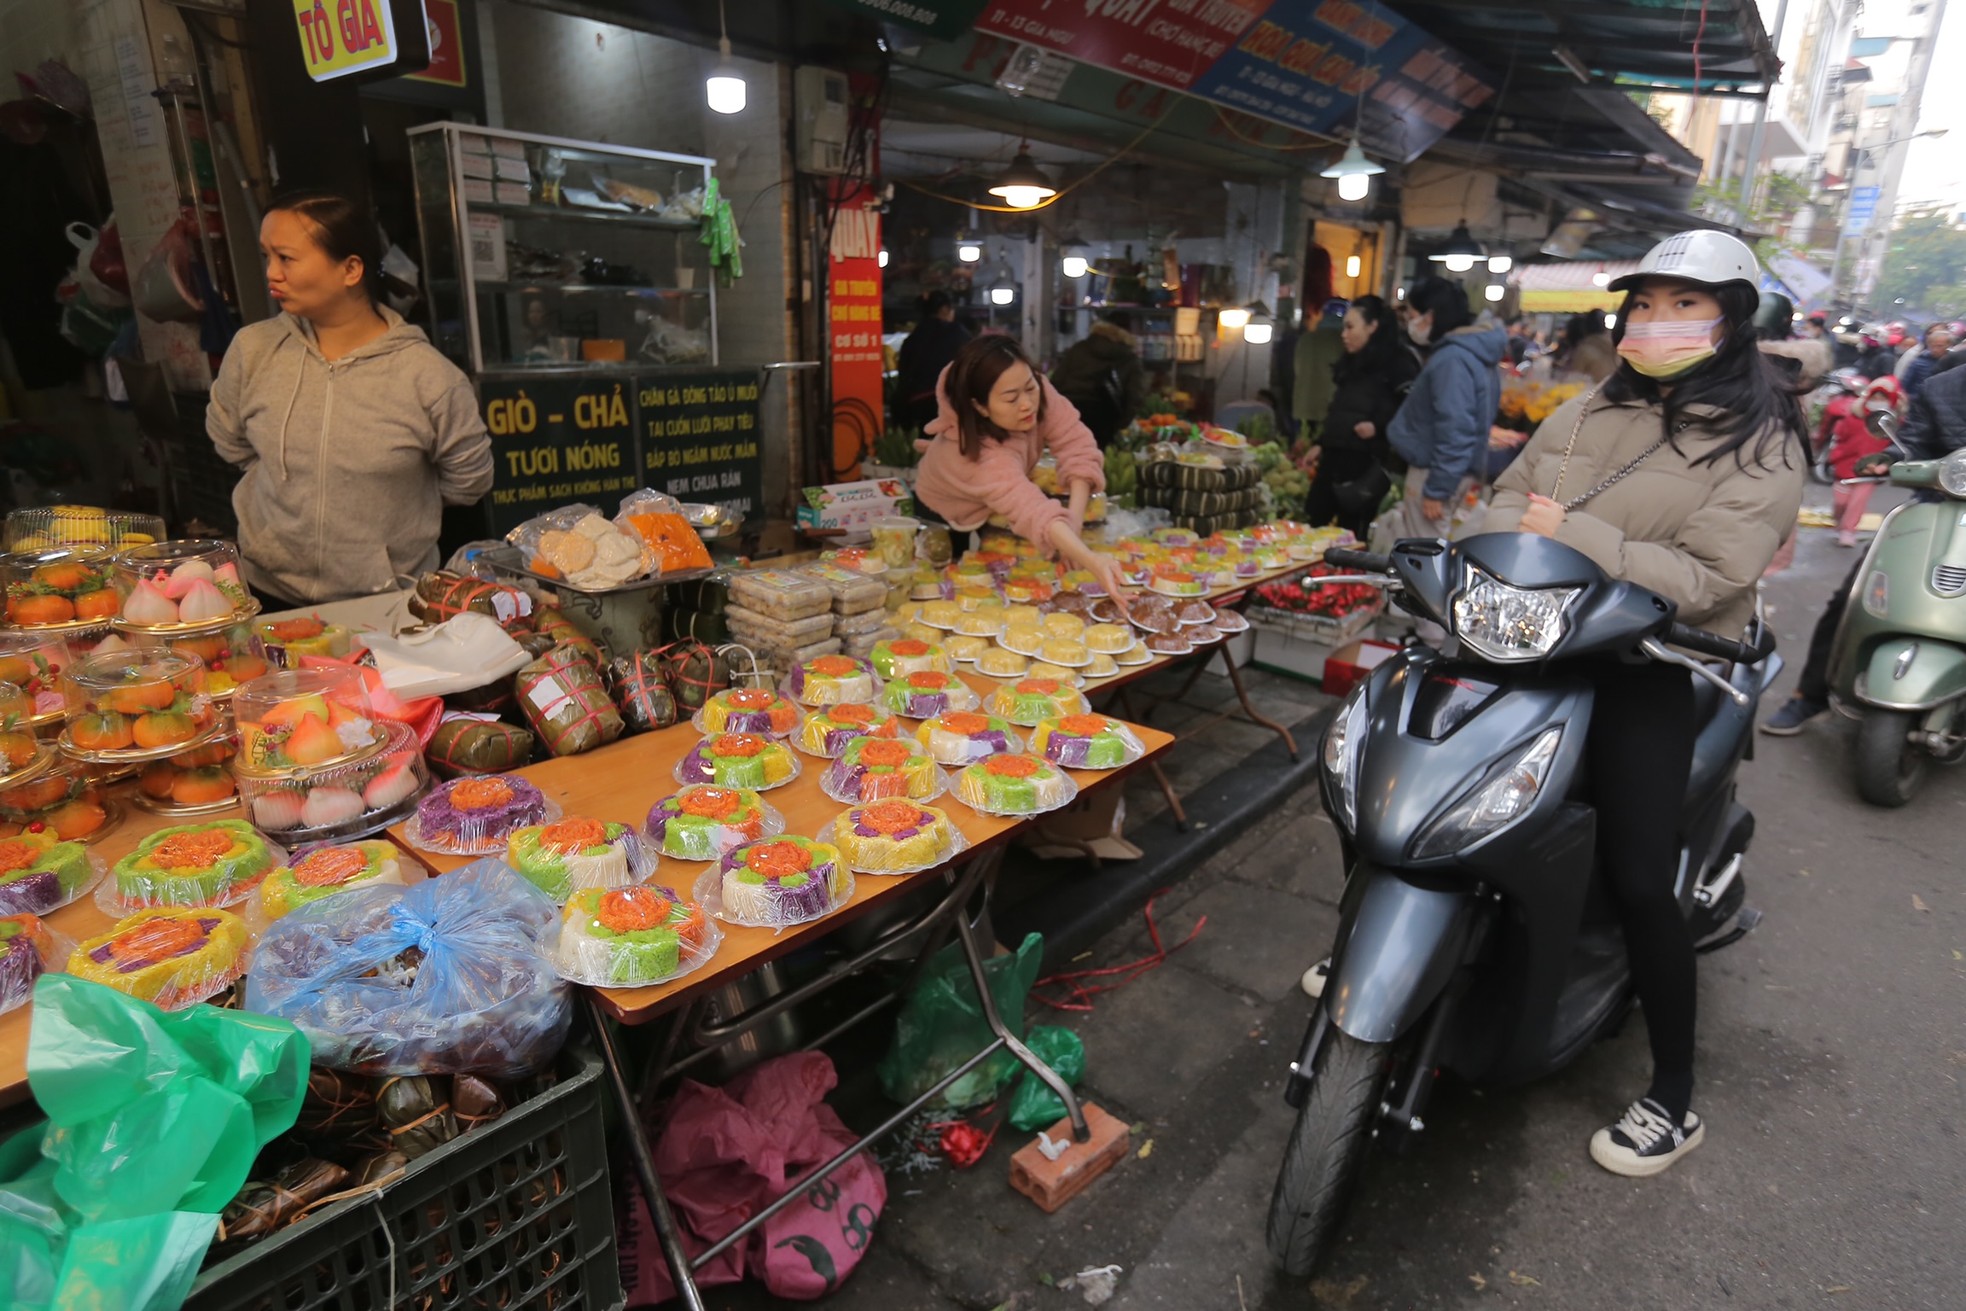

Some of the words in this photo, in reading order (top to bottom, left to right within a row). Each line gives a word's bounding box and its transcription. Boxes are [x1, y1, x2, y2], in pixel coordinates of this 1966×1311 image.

[488, 389, 537, 435] GIÒ
[548, 414, 564, 423] -
[574, 384, 629, 430] CHẢ
[640, 386, 666, 408] CHÂN
[648, 420, 664, 438] TAI
[712, 415, 736, 433] PHAY
[506, 446, 559, 478] TƯƠI
[566, 440, 620, 472] NÓNG
[667, 478, 690, 496] NEM
[692, 474, 718, 492] CHUA
[720, 468, 742, 488] RÁN
